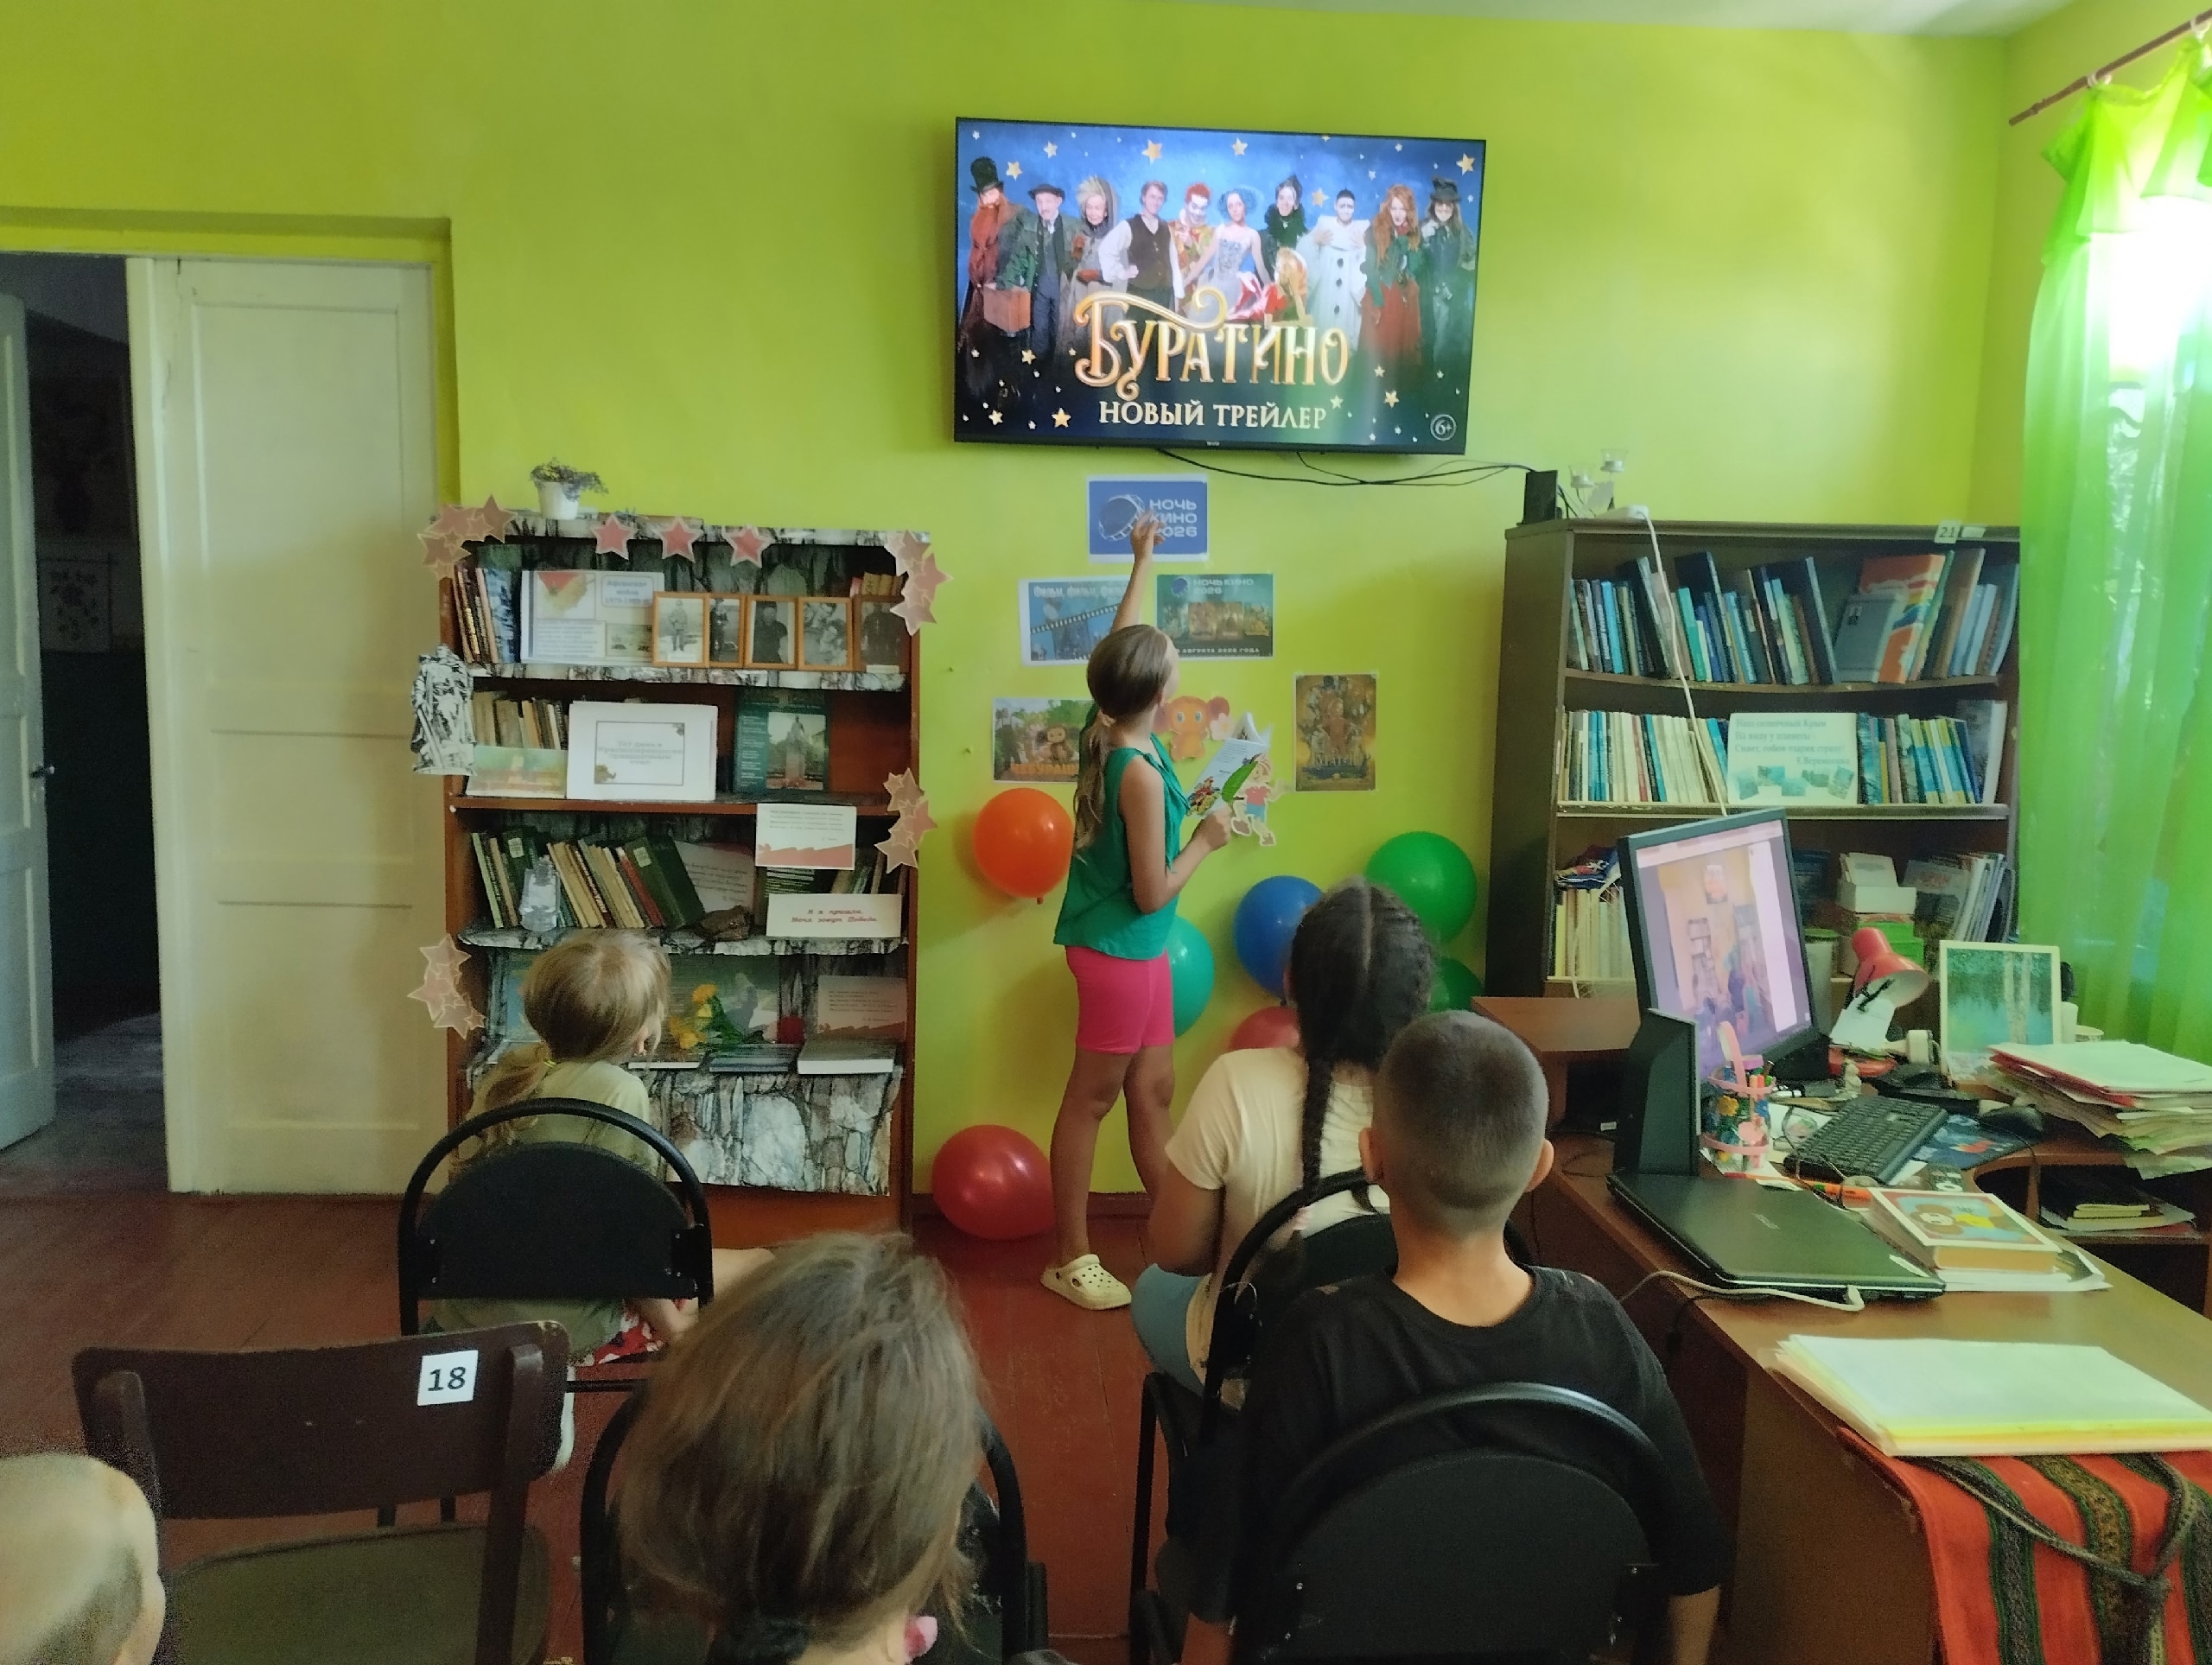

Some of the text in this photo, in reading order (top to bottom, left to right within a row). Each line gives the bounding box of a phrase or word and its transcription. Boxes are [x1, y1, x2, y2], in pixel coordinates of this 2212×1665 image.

[1074, 286, 1350, 401] БУРАТИНО
[1099, 399, 1326, 429] НОВЫЙ ТРЕЙЛЕР
[1435, 420, 1452, 435] 6+
[1149, 499, 1198, 511] НОЧЬ
[1939, 526, 1955, 537] 21
[428, 1366, 467, 1392] 18
